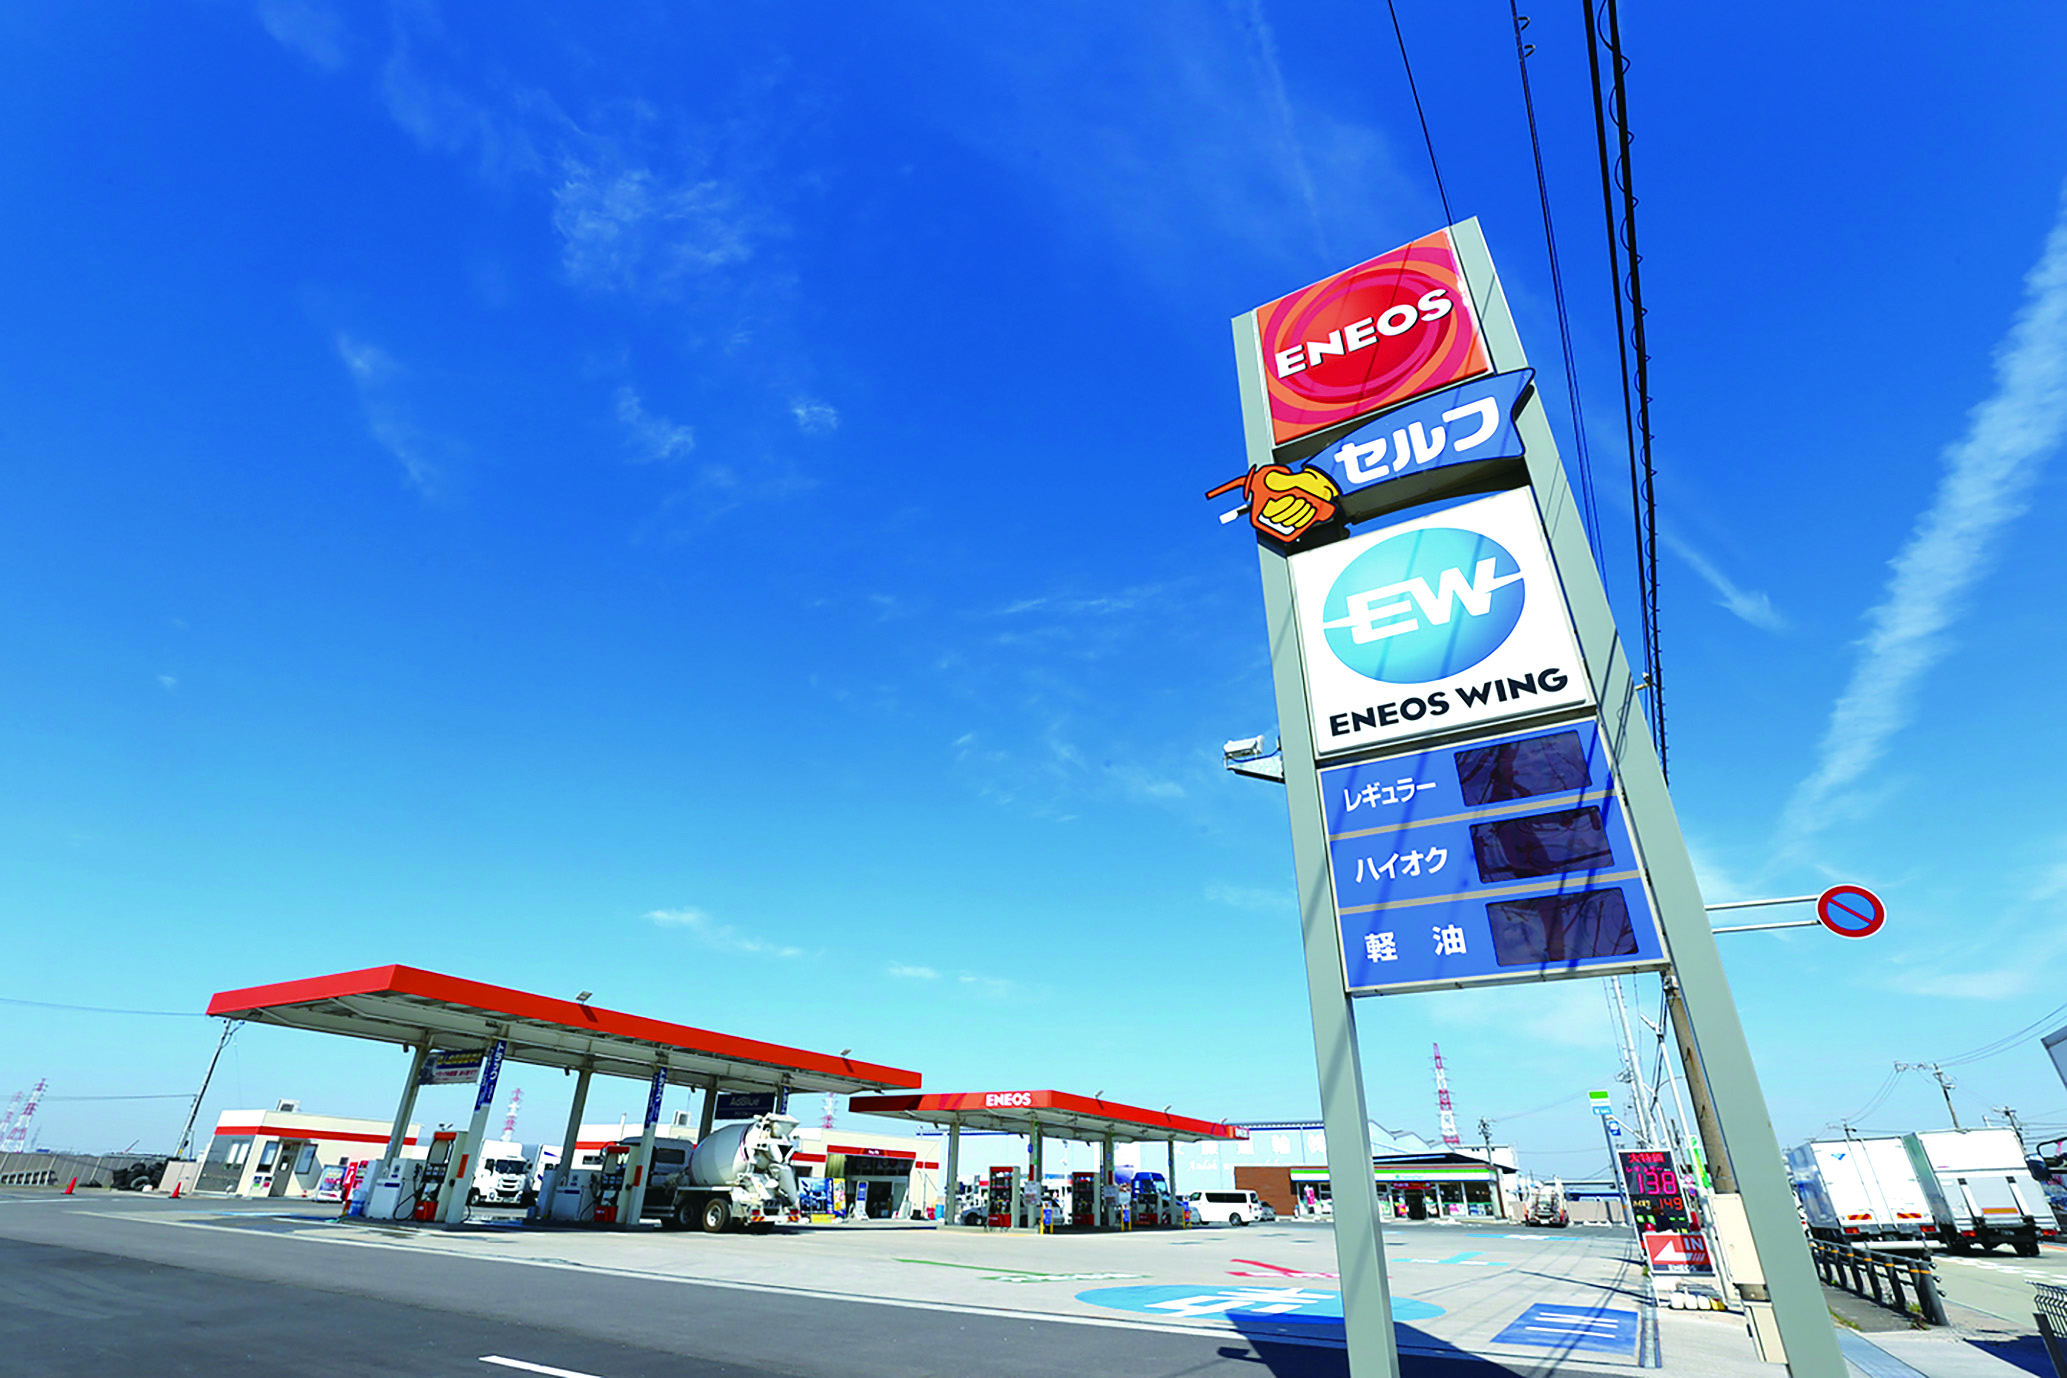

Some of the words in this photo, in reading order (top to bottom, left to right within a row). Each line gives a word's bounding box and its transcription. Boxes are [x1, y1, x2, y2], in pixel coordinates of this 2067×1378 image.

[1275, 288, 1453, 378] ENEOS
[1335, 397, 1500, 484] セルフ
[1335, 557, 1511, 645] EW
[1329, 691, 1450, 737] ENEOS
[1455, 667, 1568, 709] WING
[1344, 777, 1436, 812] レギュラー
[1355, 846, 1448, 883] ハイオク
[985, 1092, 1032, 1107] ENEOS
[1636, 1171, 1678, 1195] 138
[1659, 1197, 1684, 1210] 149
[1683, 1237, 1704, 1250] IN
